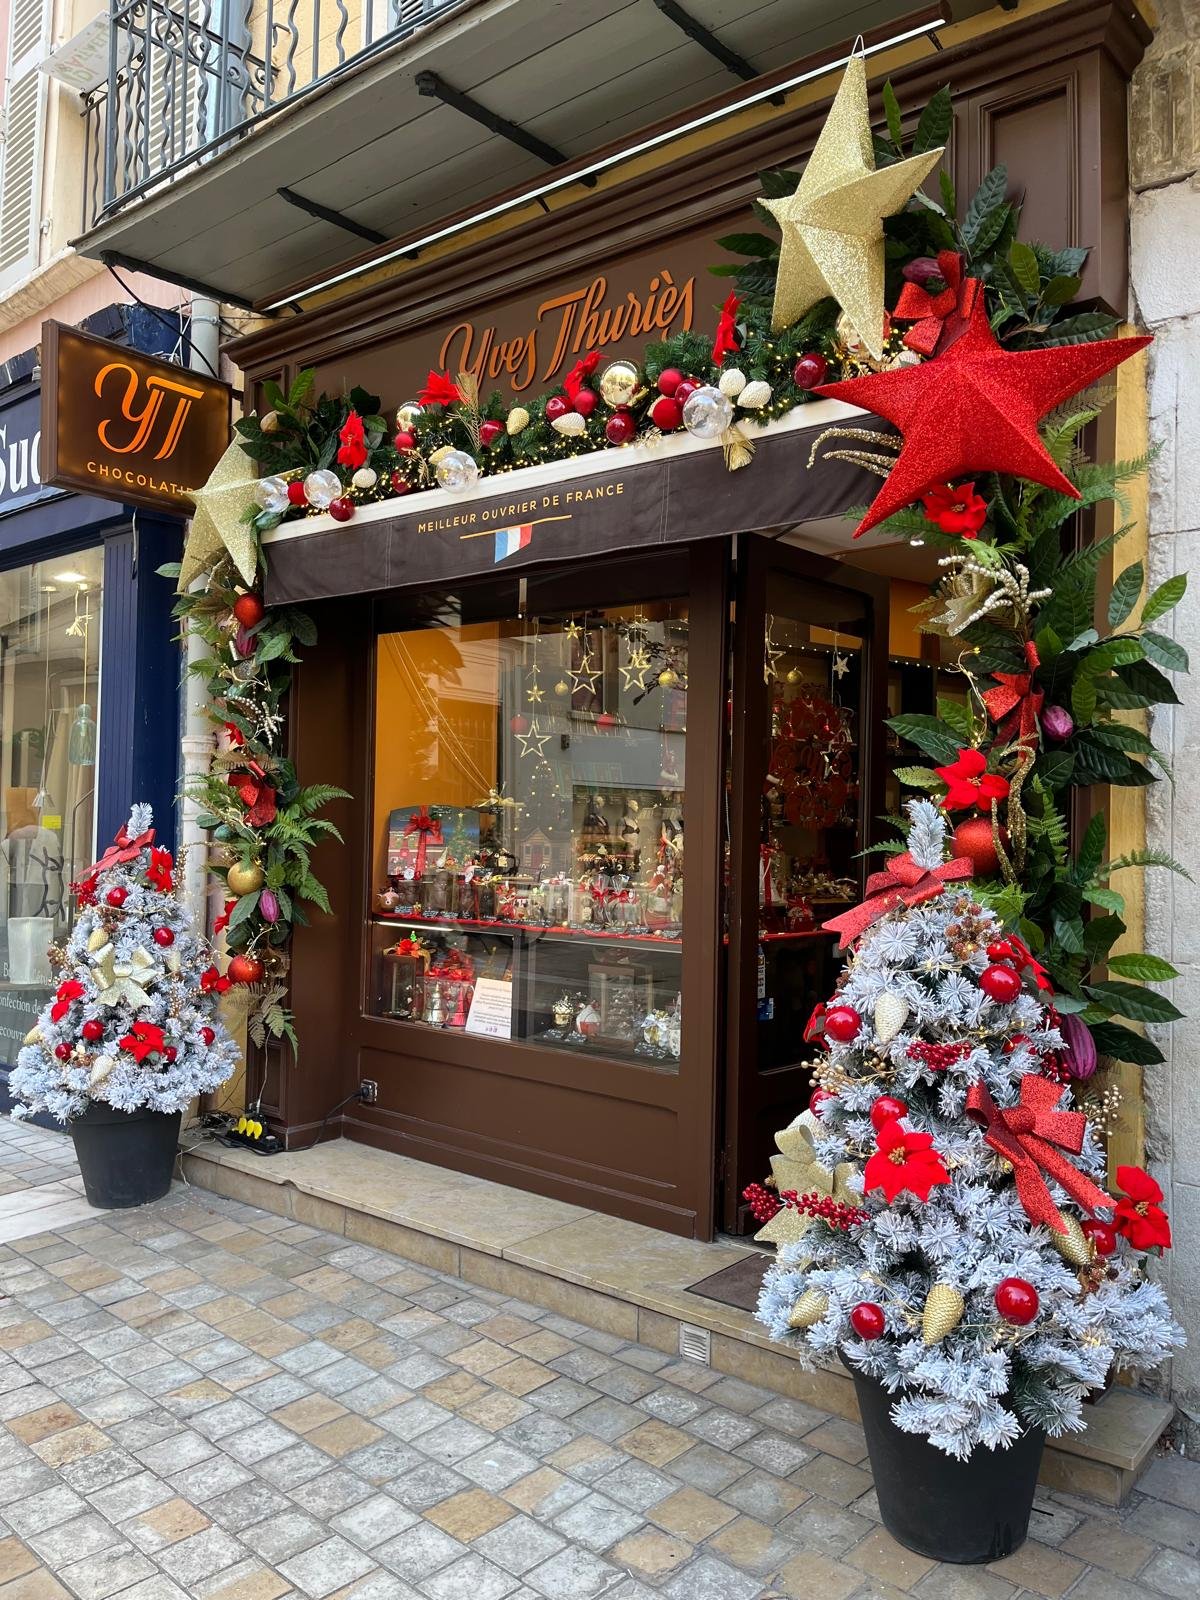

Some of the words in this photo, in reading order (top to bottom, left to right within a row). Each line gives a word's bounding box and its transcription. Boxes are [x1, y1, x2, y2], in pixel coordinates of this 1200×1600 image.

[439, 322, 538, 392] Yves
[537, 269, 695, 382] Thuriès
[94, 363, 204, 460] YT
[418, 513, 477, 534] MEILLEUR
[482, 500, 537, 522] OUVRIER
[543, 496, 559, 508] DE
[566, 483, 625, 504] FRANCE
